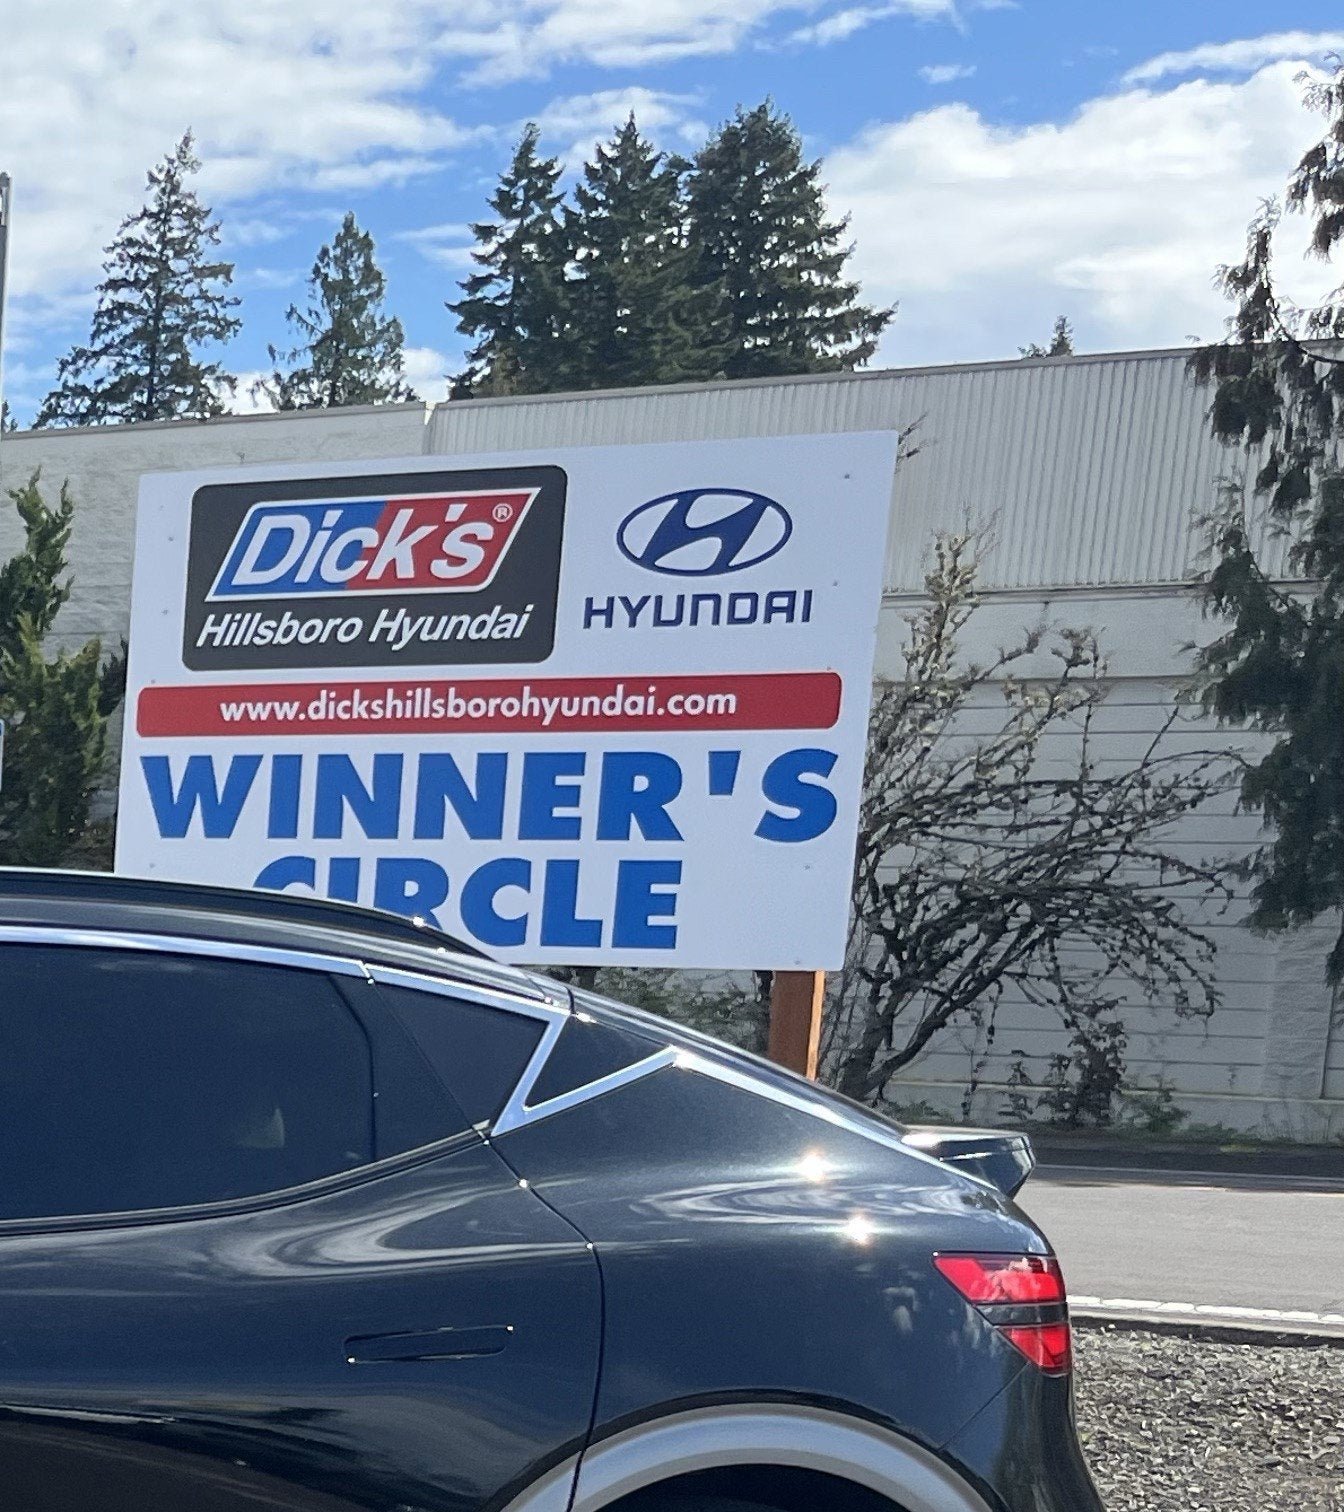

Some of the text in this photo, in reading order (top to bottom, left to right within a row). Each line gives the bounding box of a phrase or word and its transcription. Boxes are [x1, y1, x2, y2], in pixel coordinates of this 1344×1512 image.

[196, 604, 534, 651] Hillsboro Hyundai
[582, 589, 813, 629] HYUNDAI
[220, 685, 737, 726] www.dickshillsborohyundai.com
[140, 748, 839, 843] WINNER'S
